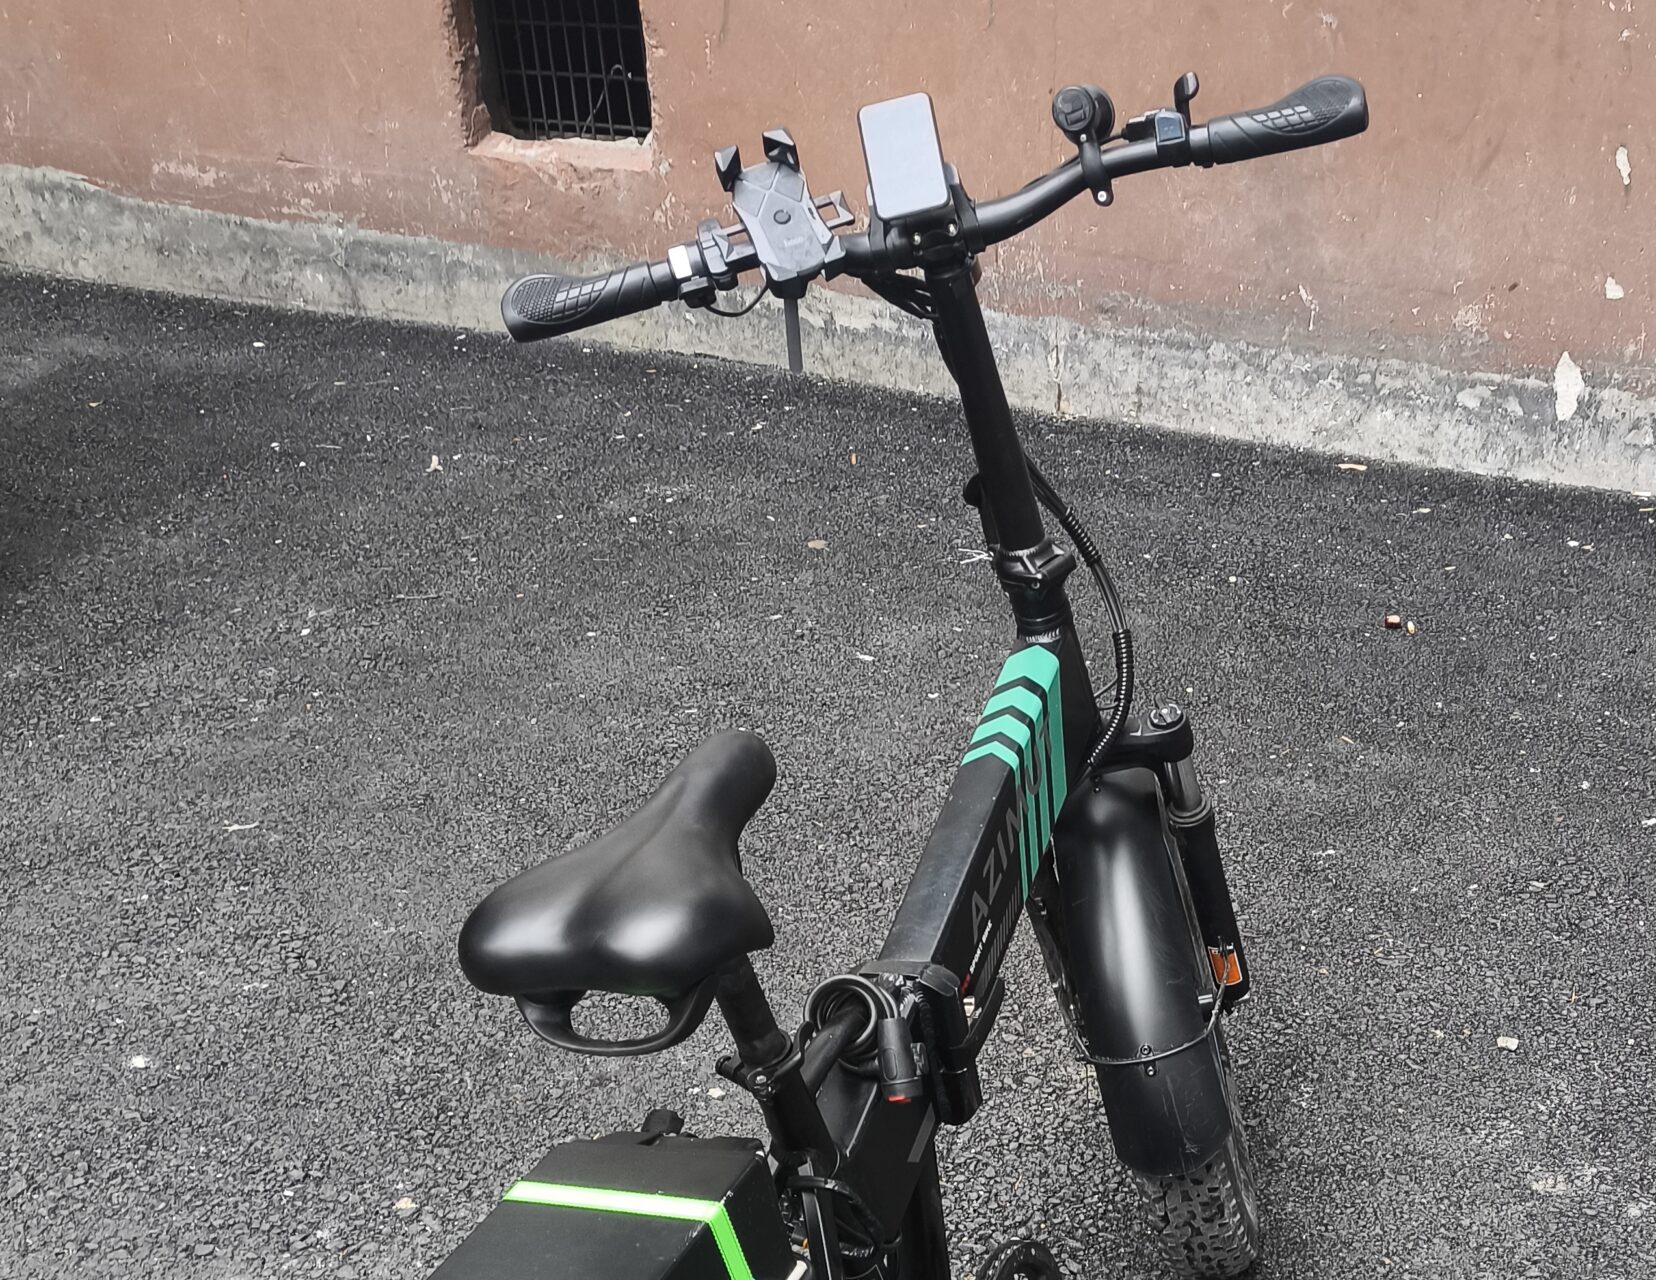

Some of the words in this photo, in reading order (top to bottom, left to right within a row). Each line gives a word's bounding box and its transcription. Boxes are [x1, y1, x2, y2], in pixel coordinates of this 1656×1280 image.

[971, 711, 1053, 945] AZIMUT
[969, 942, 983, 975] SPORT
[981, 919, 993, 944] BIKE
